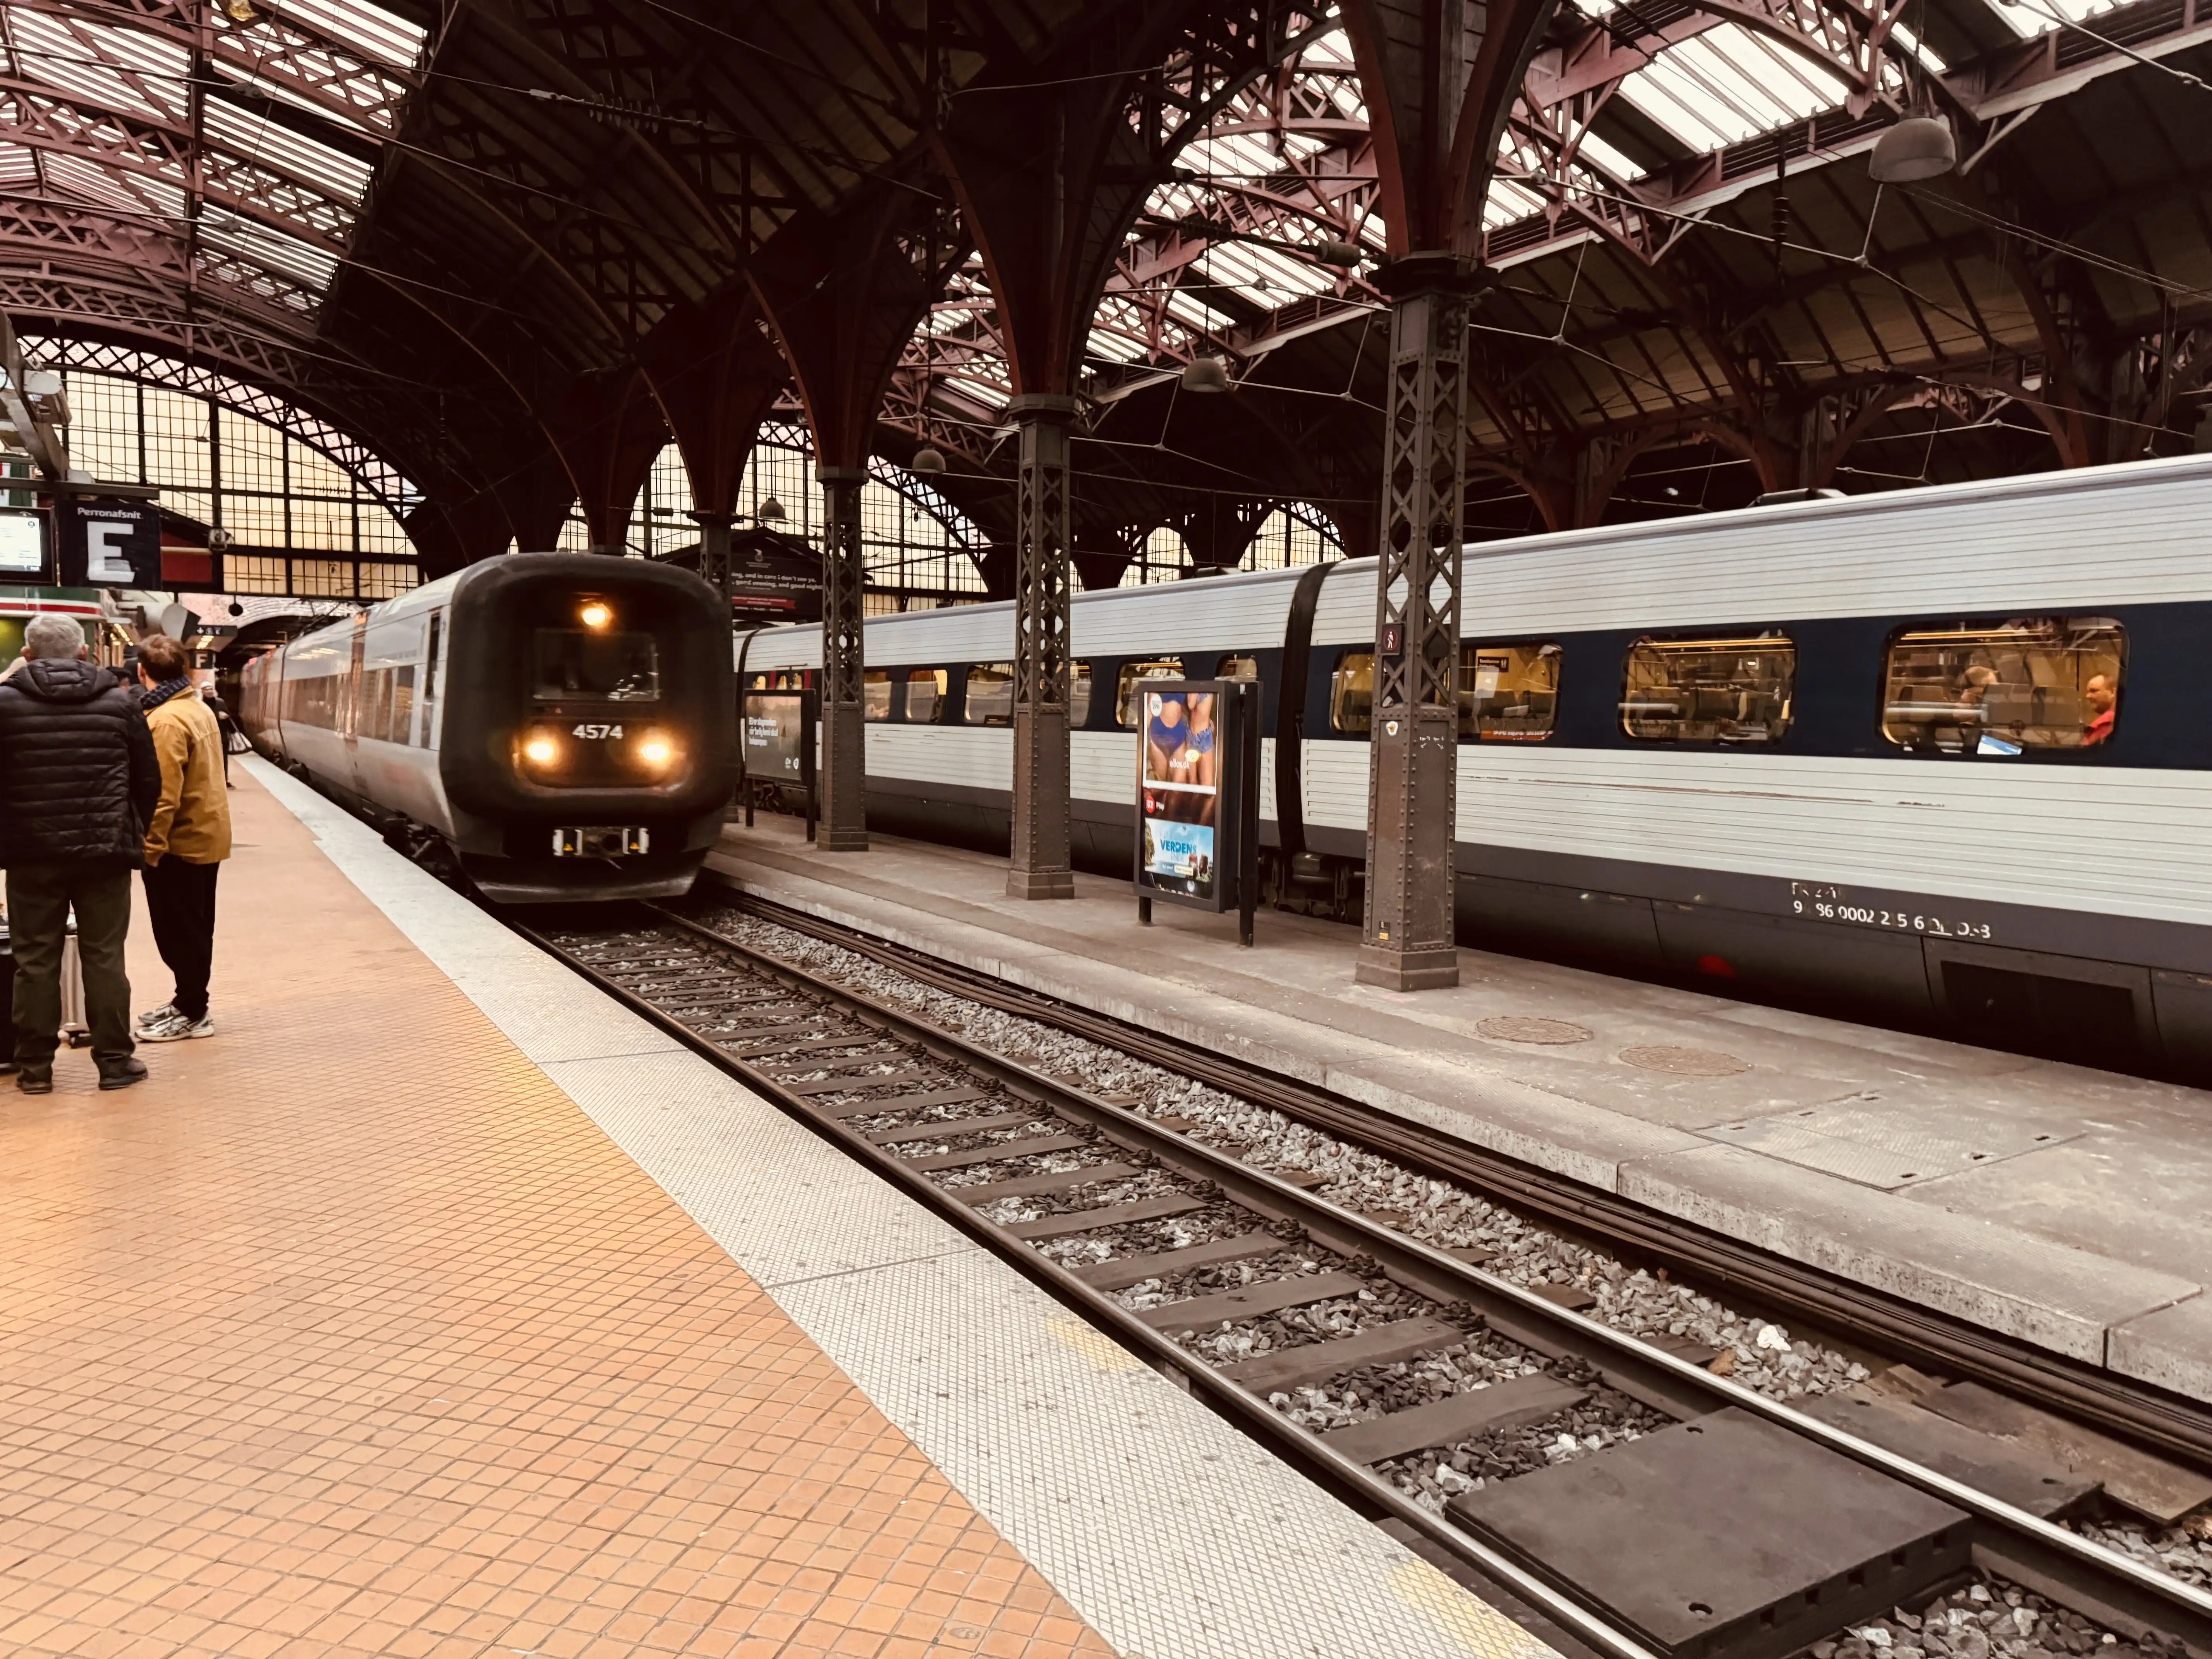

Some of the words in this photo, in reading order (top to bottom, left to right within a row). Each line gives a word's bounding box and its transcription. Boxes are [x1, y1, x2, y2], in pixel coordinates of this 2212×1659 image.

[77, 507, 142, 519] Perronafsnit
[87, 521, 135, 583] E
[195, 653, 208, 668] F
[572, 724, 624, 739] 4574
[1160, 839, 1197, 854] VERDENS
